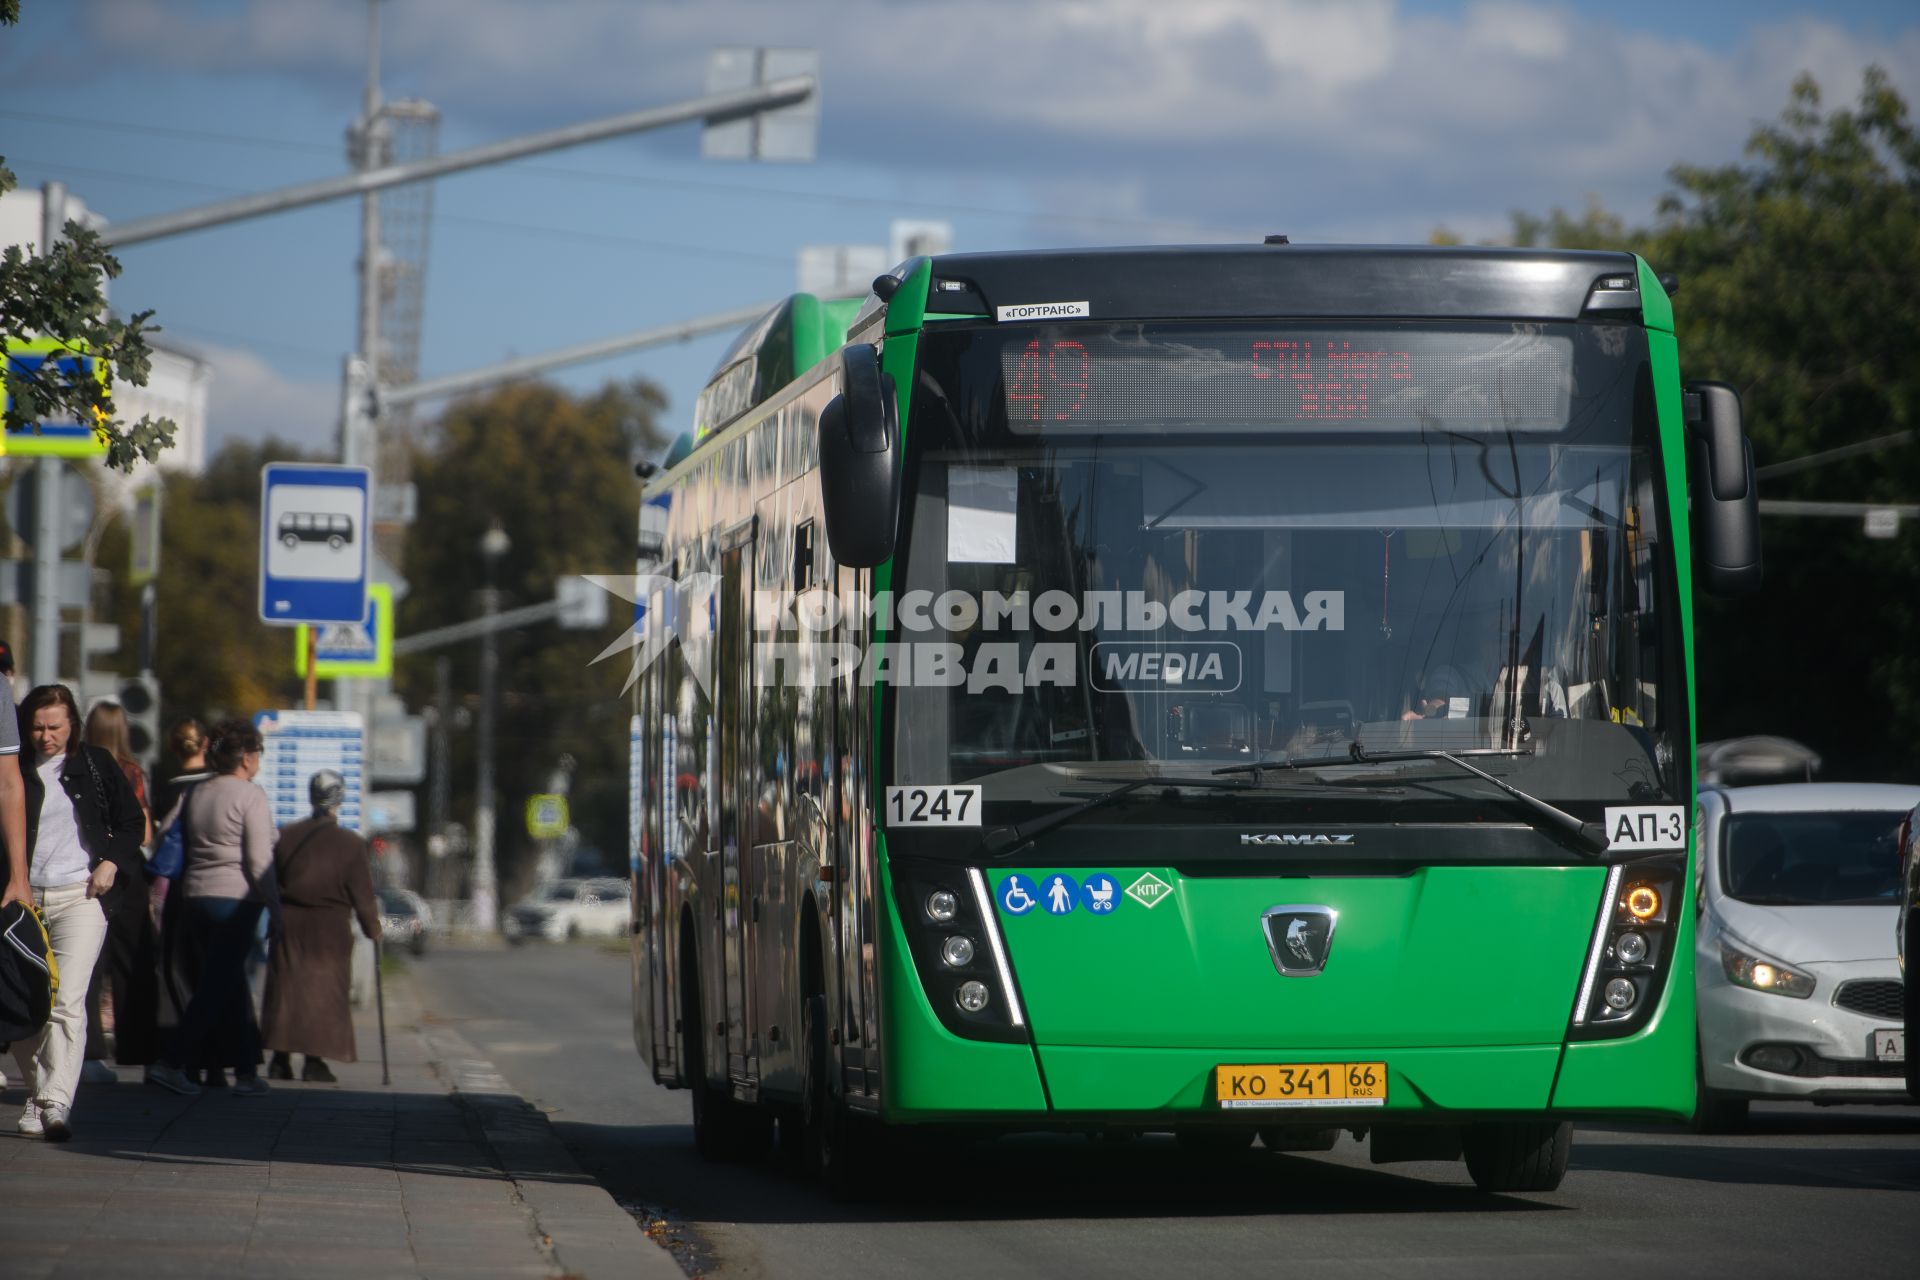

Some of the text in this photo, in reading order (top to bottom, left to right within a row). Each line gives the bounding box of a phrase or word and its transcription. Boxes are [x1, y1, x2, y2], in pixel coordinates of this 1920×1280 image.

[1005, 305, 1082, 318] «ГОРТРАНС»
[1008, 339, 1089, 421] 49
[891, 788, 974, 822] 1247
[1613, 812, 1682, 843] АП-3
[1240, 834, 1355, 845] KAMAZ
[1137, 884, 1162, 896] КПГ
[1279, 1068, 1331, 1095] 341
[1349, 1066, 1376, 1087] 66
[1352, 1087, 1374, 1096] RUS
